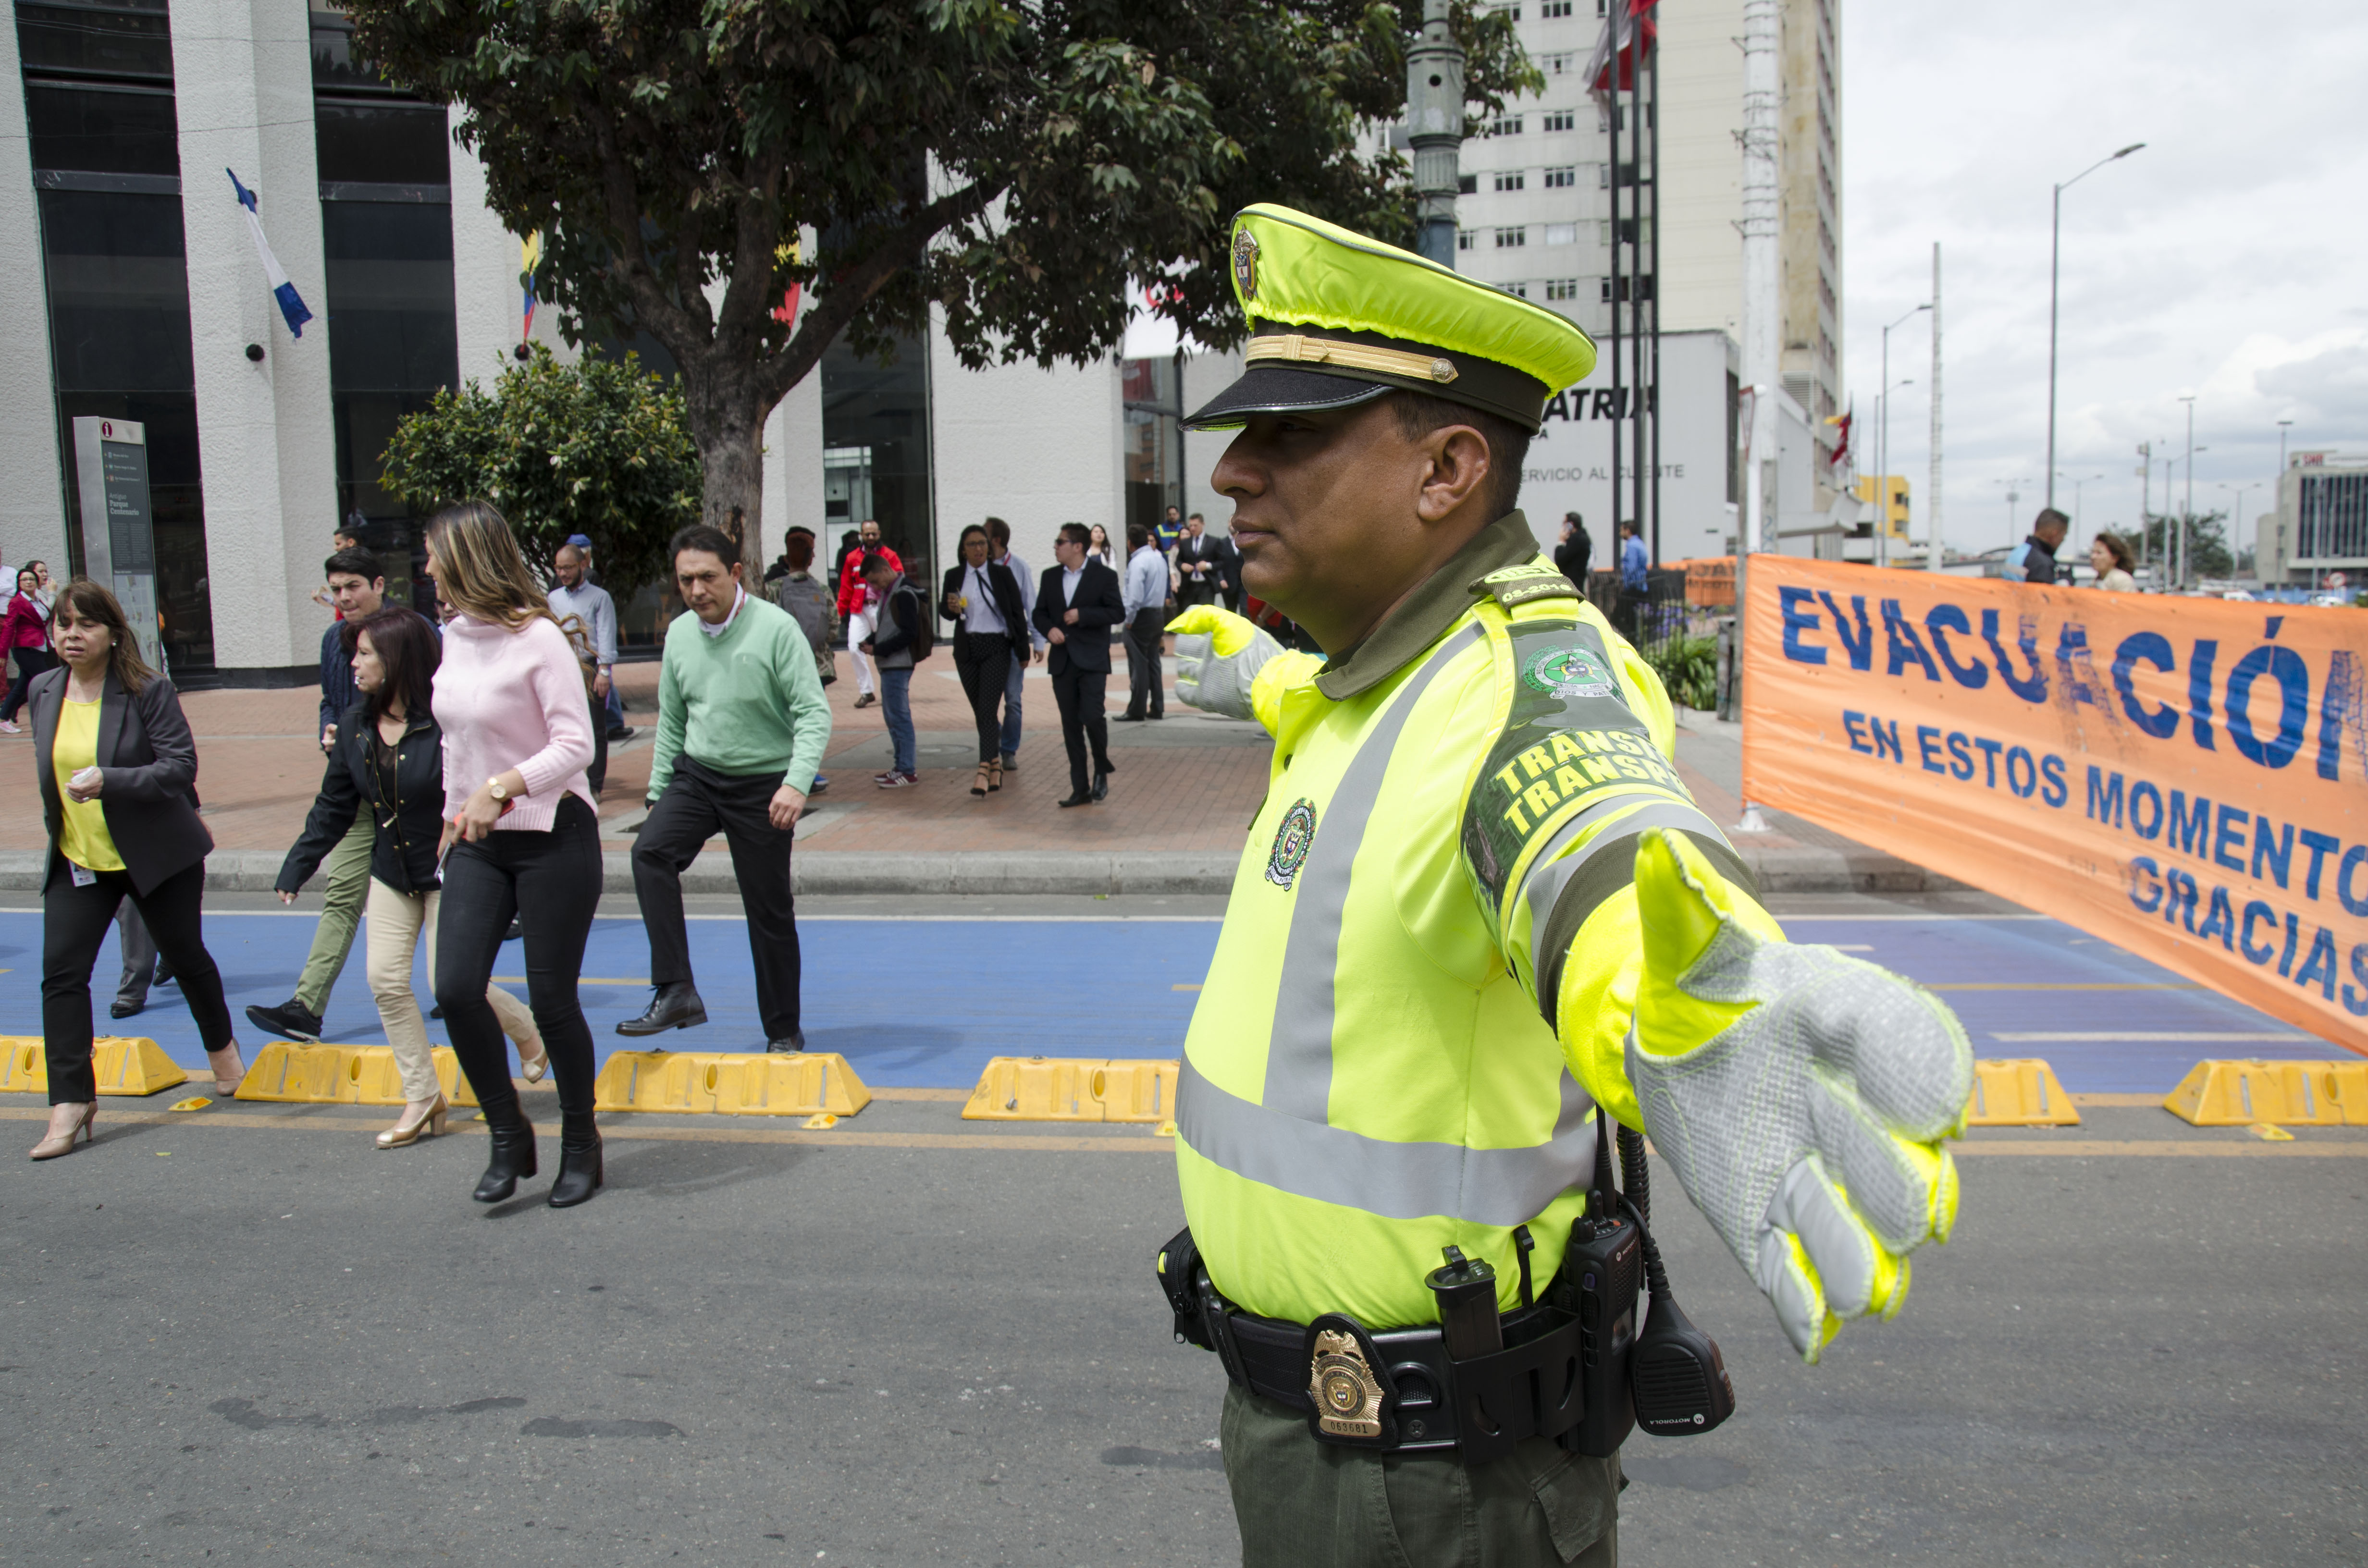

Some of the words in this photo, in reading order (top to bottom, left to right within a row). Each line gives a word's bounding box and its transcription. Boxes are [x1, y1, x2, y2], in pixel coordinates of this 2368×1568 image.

[1588, 466, 1608, 480] AL
[1619, 464, 1685, 478] CLETE
[109, 492, 127, 501] Antiguo
[110, 500, 129, 508] Parque
[1843, 710, 1903, 764] EN
[1917, 725, 2068, 808] ESTOS
[2128, 856, 2368, 1016] GRACIAS
[1331, 1421, 1368, 1433] 063681
